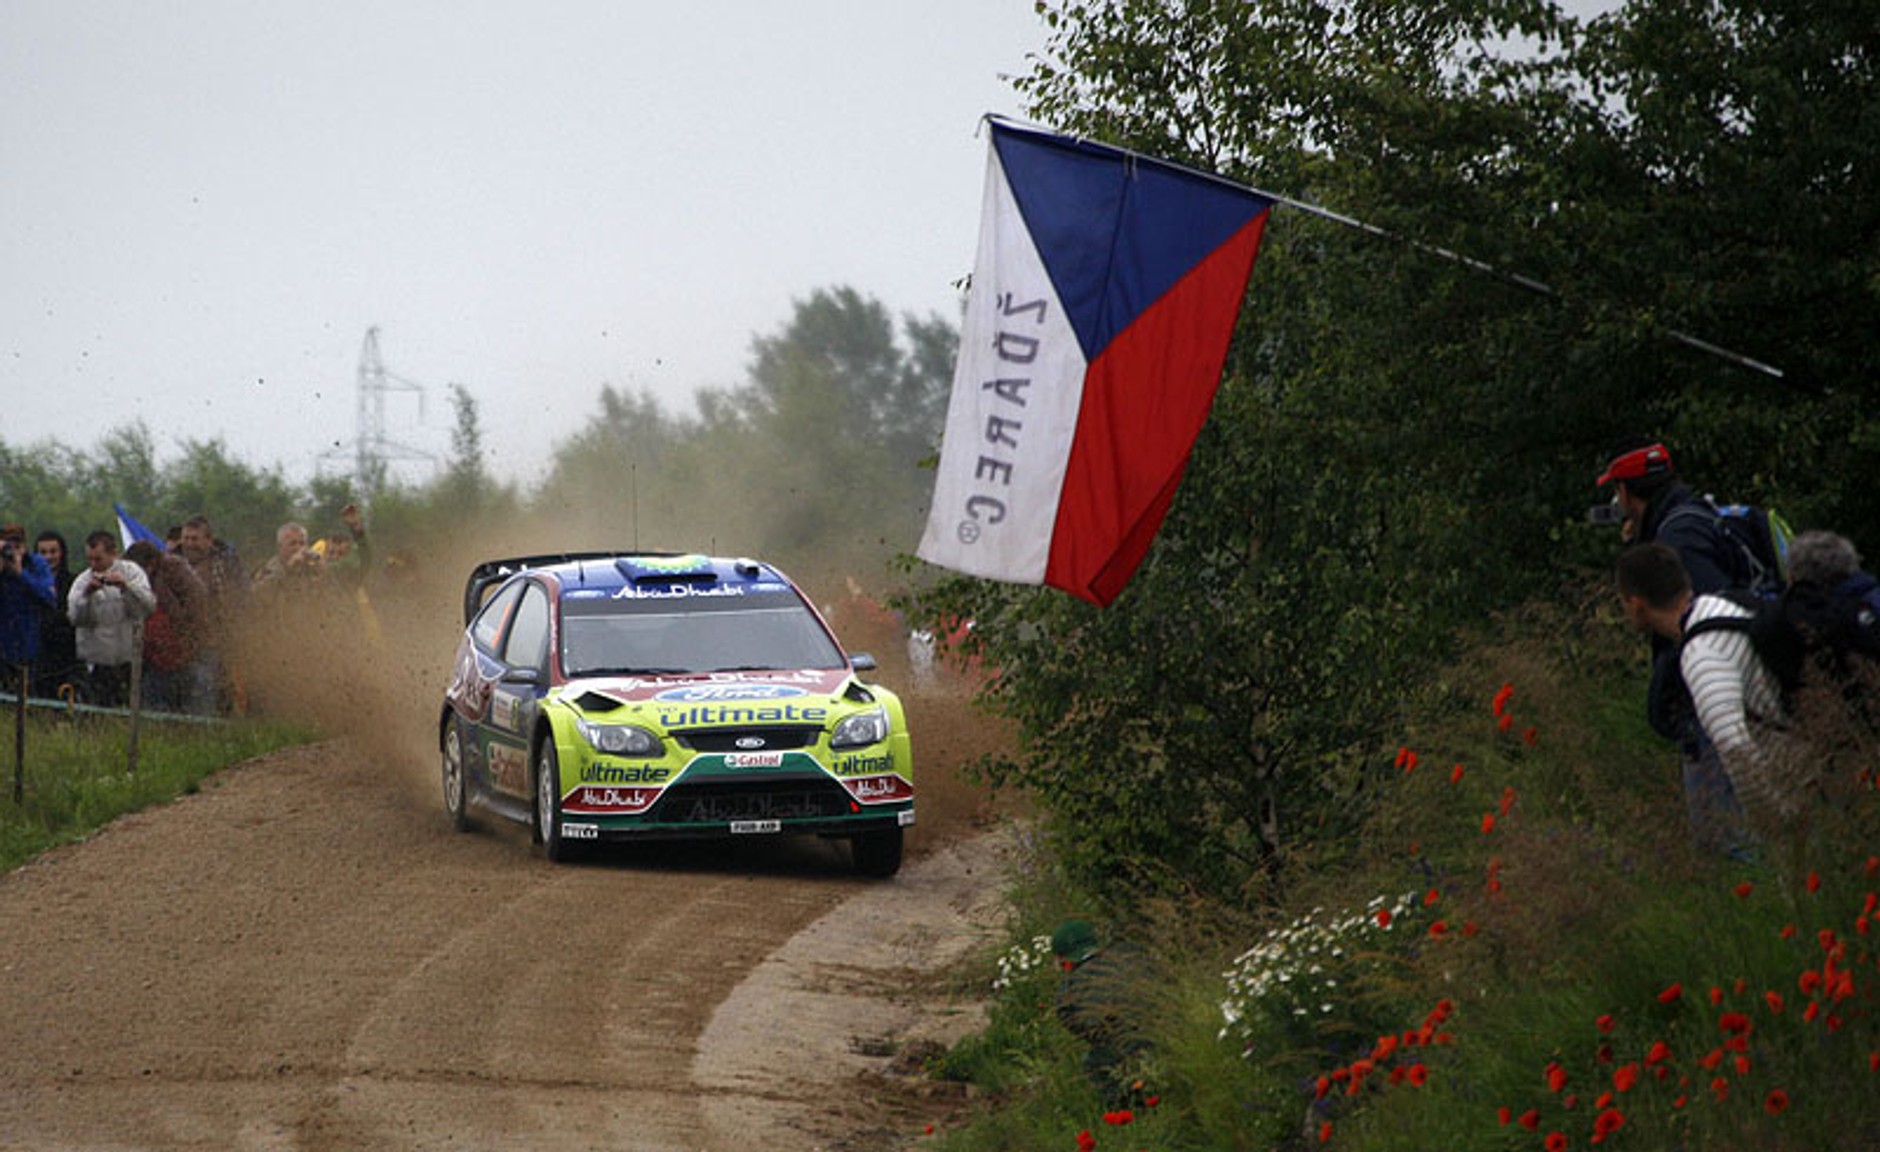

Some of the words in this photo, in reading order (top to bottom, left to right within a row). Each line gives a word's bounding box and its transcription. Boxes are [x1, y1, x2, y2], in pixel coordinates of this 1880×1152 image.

[660, 704, 827, 727] ultimate
[738, 754, 779, 766] Castrol
[580, 762, 670, 782] ultimate
